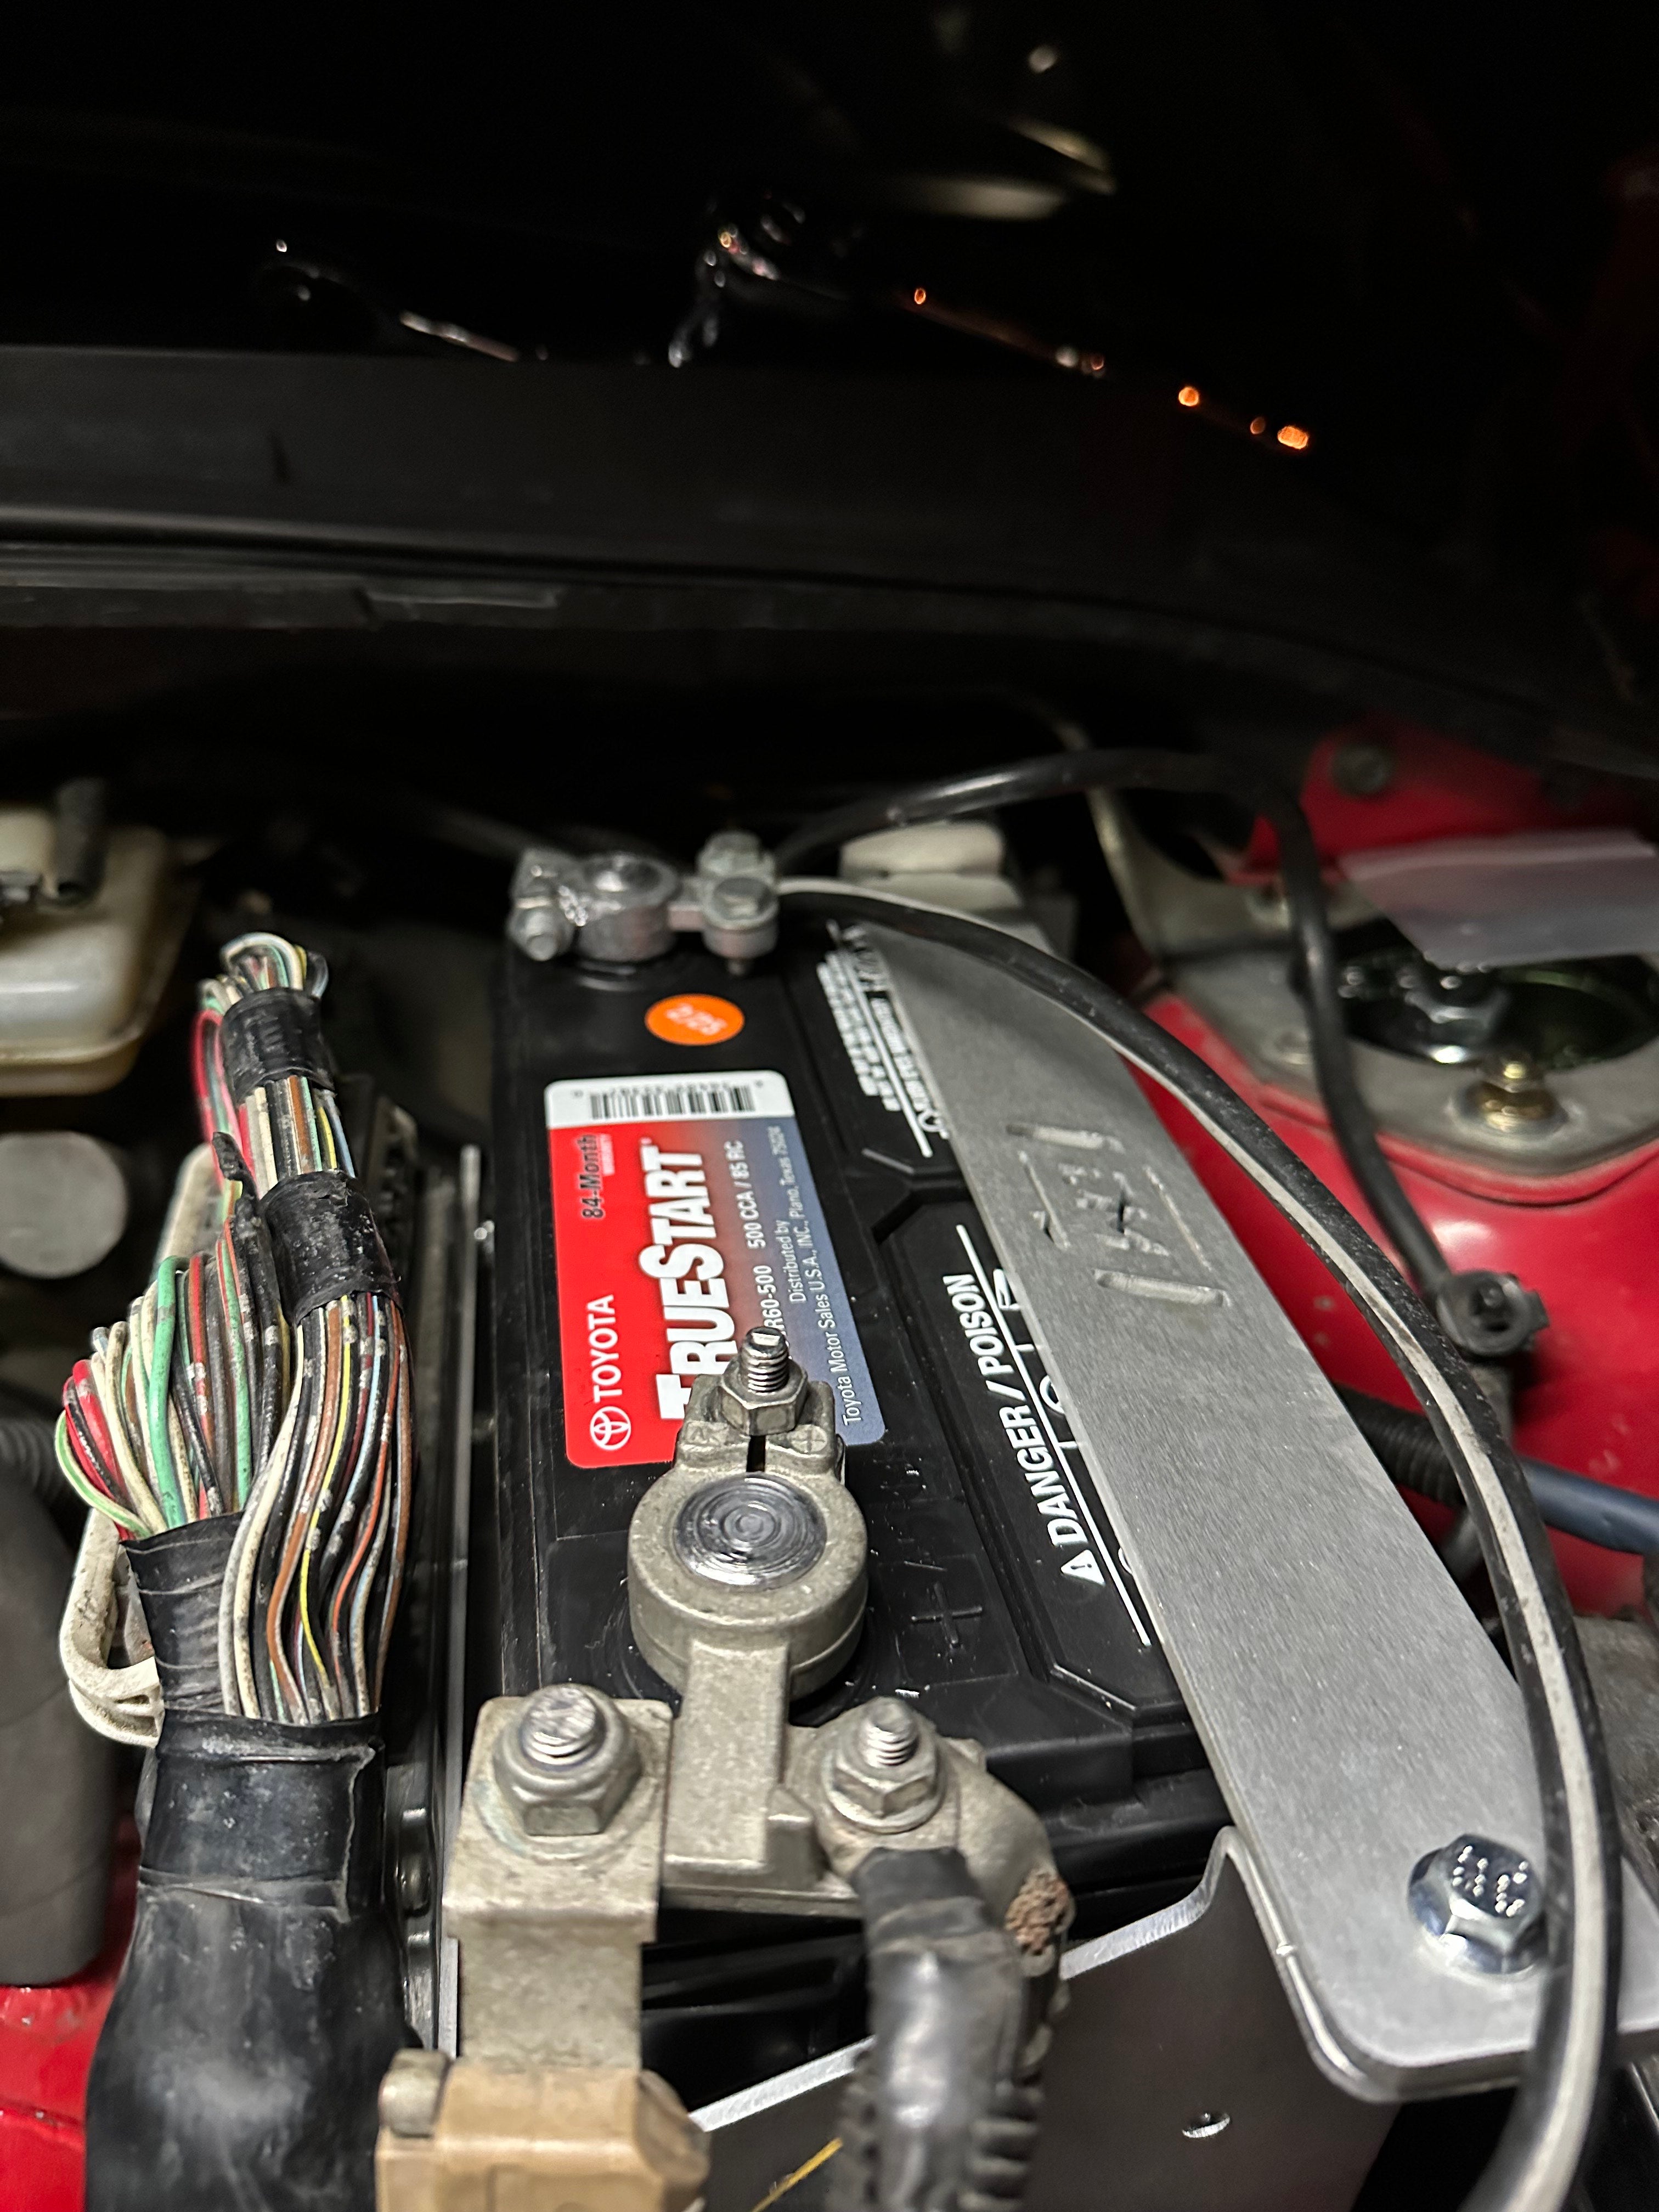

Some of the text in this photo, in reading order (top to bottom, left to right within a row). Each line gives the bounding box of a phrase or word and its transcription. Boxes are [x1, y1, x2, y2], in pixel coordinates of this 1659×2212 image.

[724, 1141, 746, 1160] RC
[577, 1135, 603, 1218] 84-Month
[729, 1163, 749, 1178] 85
[778, 1157, 794, 1186] Texas
[736, 1190, 759, 1220] CCA
[786, 1186, 805, 1218] Plano,
[744, 1223, 766, 1249] 500
[774, 1219, 806, 1302] Distributed by
[815, 1294, 837, 1328] Sales
[588, 1294, 622, 1403] TOYOTA
[823, 1332, 848, 1372] Motor
[837, 1376, 863, 1426] Toyota
[943, 1274, 1087, 1546] DANGER / POISON
